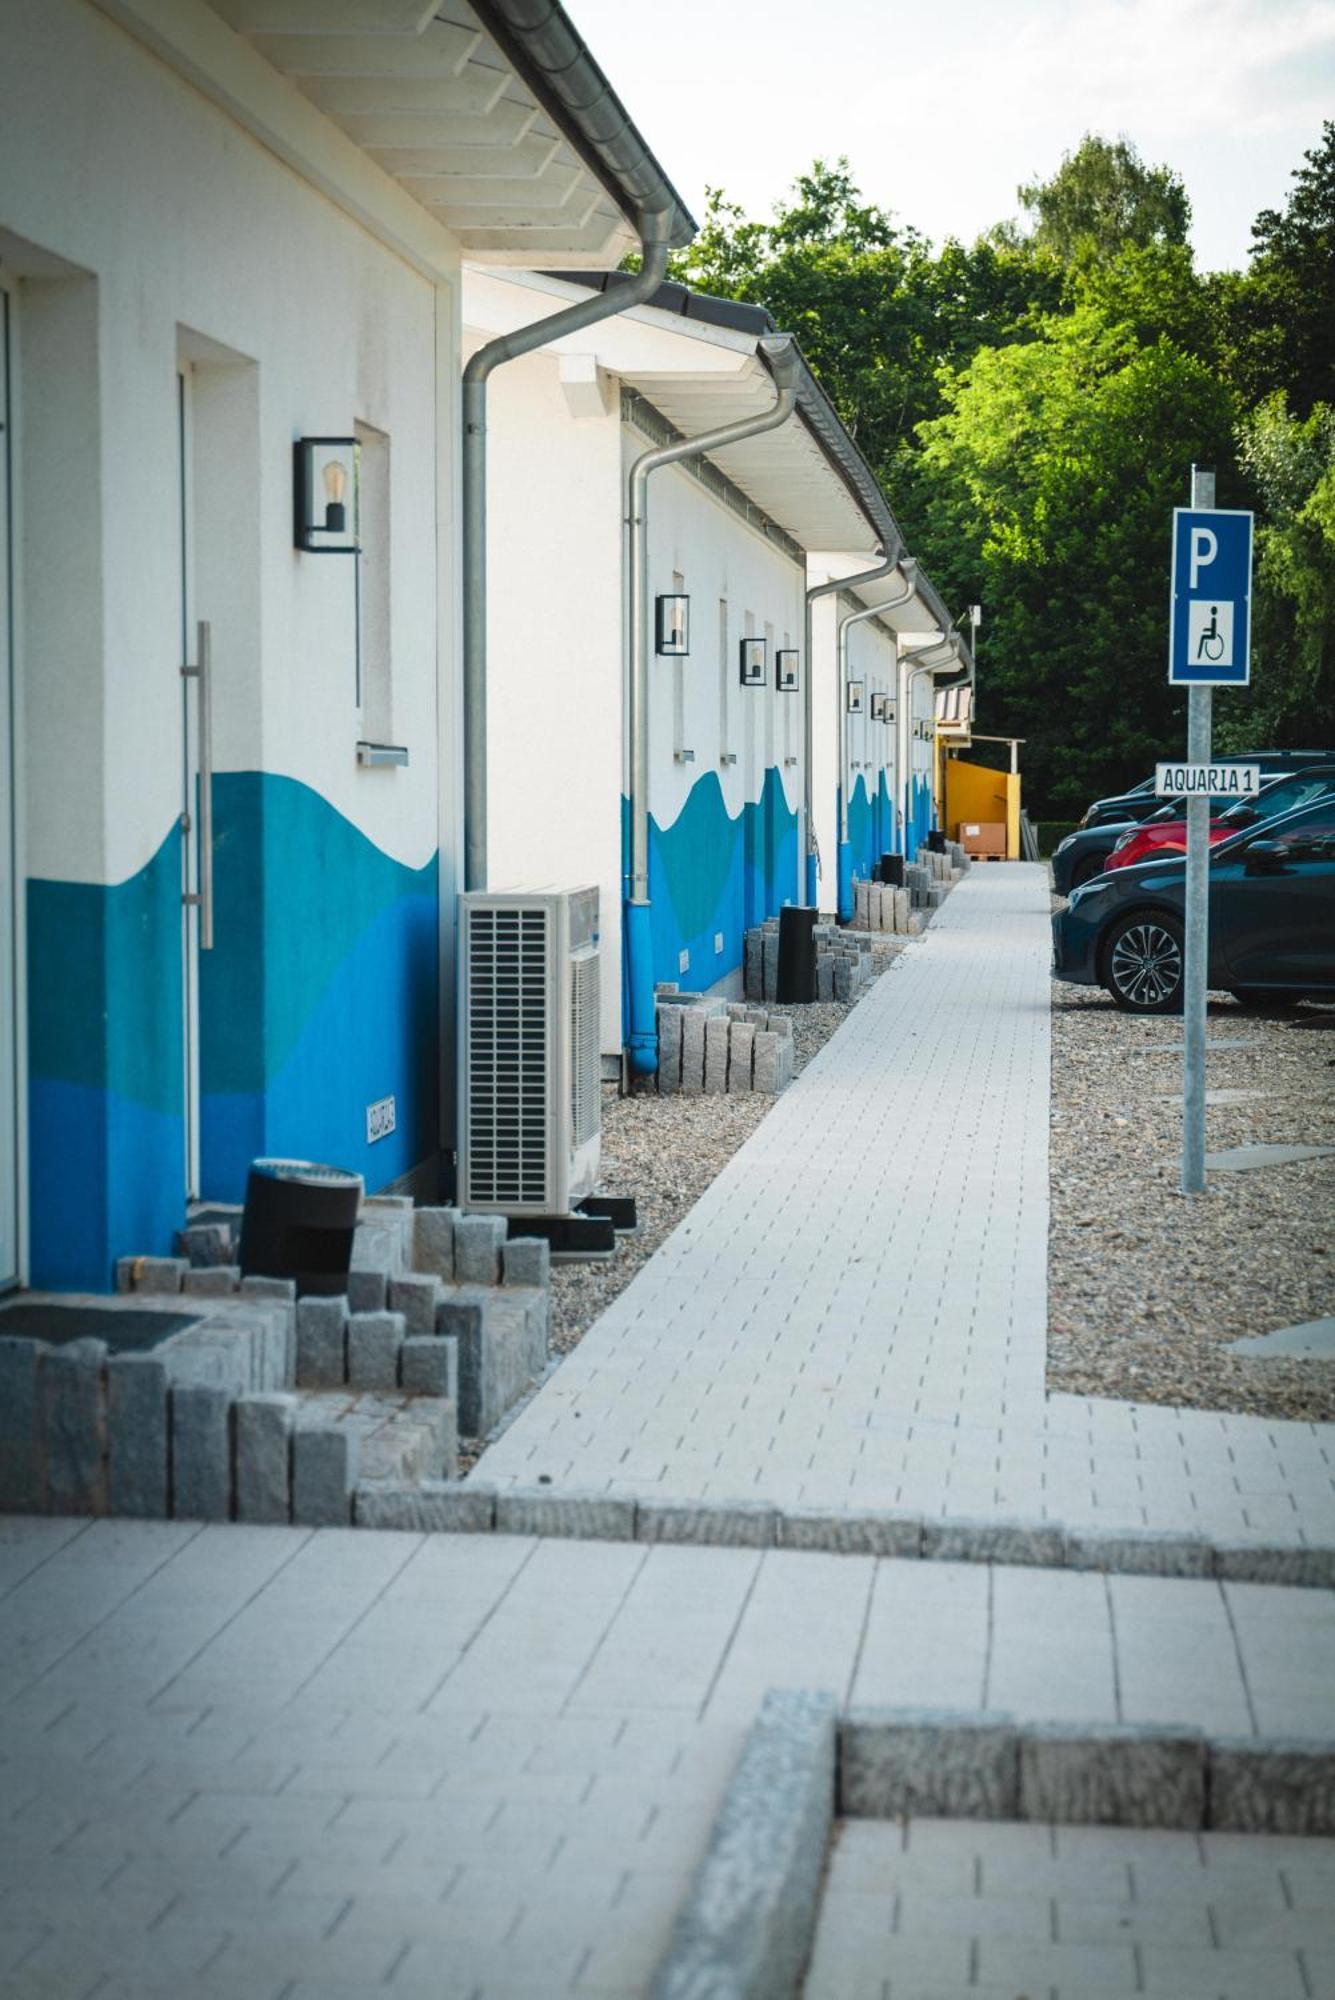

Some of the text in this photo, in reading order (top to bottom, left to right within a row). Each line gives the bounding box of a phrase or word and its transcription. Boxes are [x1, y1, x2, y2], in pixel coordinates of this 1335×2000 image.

[1190, 527, 1218, 589] P
[1163, 768, 1253, 792] AQUARIA 1
